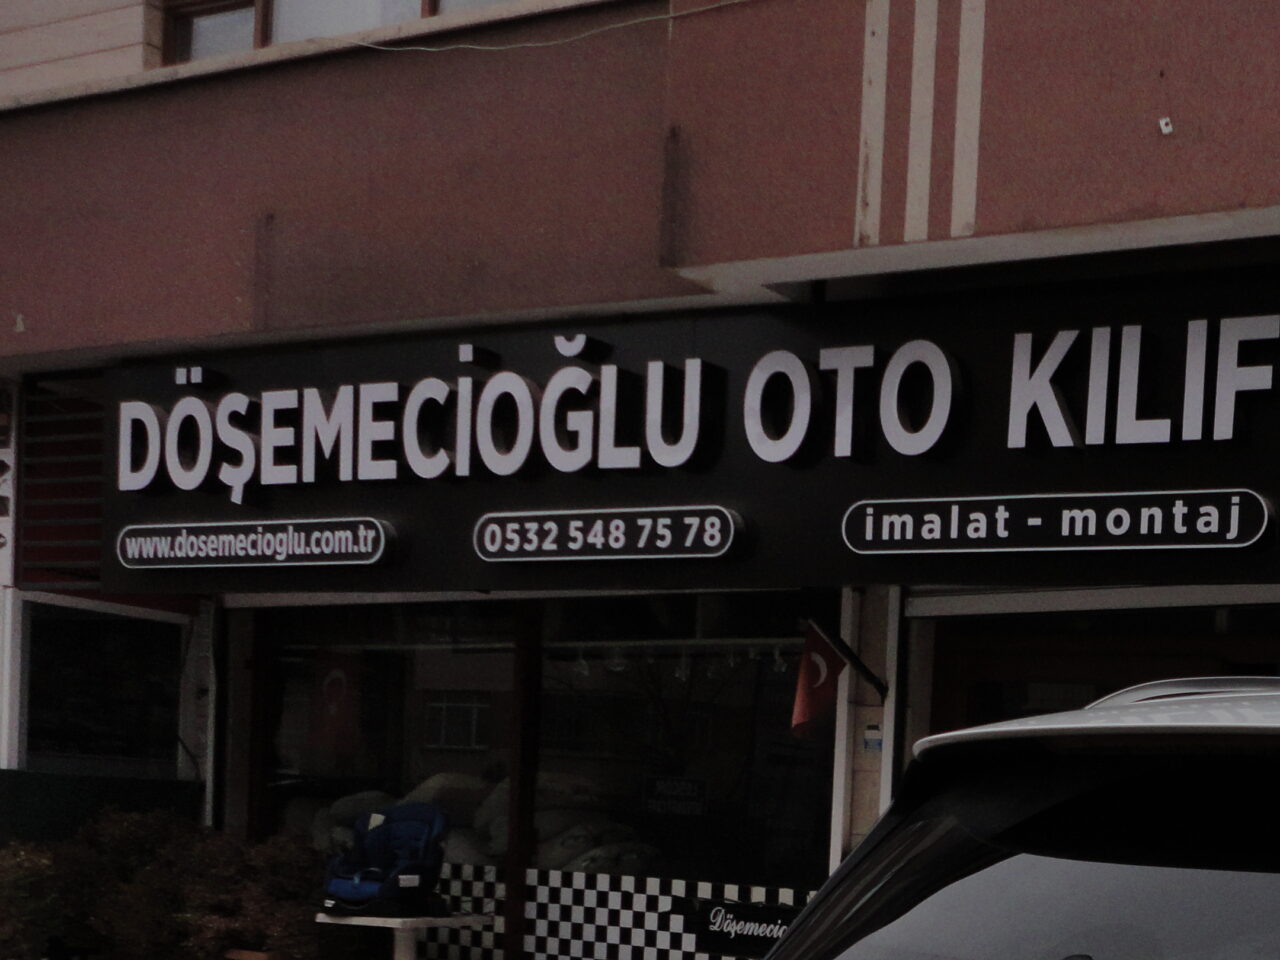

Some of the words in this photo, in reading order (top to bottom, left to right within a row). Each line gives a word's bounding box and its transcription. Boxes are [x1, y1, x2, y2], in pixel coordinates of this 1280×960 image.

[118, 334, 701, 505] DÖŞEMECİOĞLU
[743, 338, 954, 464] OTO
[484, 522, 559, 553] 0532
[567, 518, 626, 550] 548
[637, 517, 673, 549] 75
[683, 516, 722, 548] 78
[864, 505, 1010, 541] imalat
[1060, 497, 1240, 540] montaj
[125, 527, 376, 562] www.dosemecioglu.com.tr
